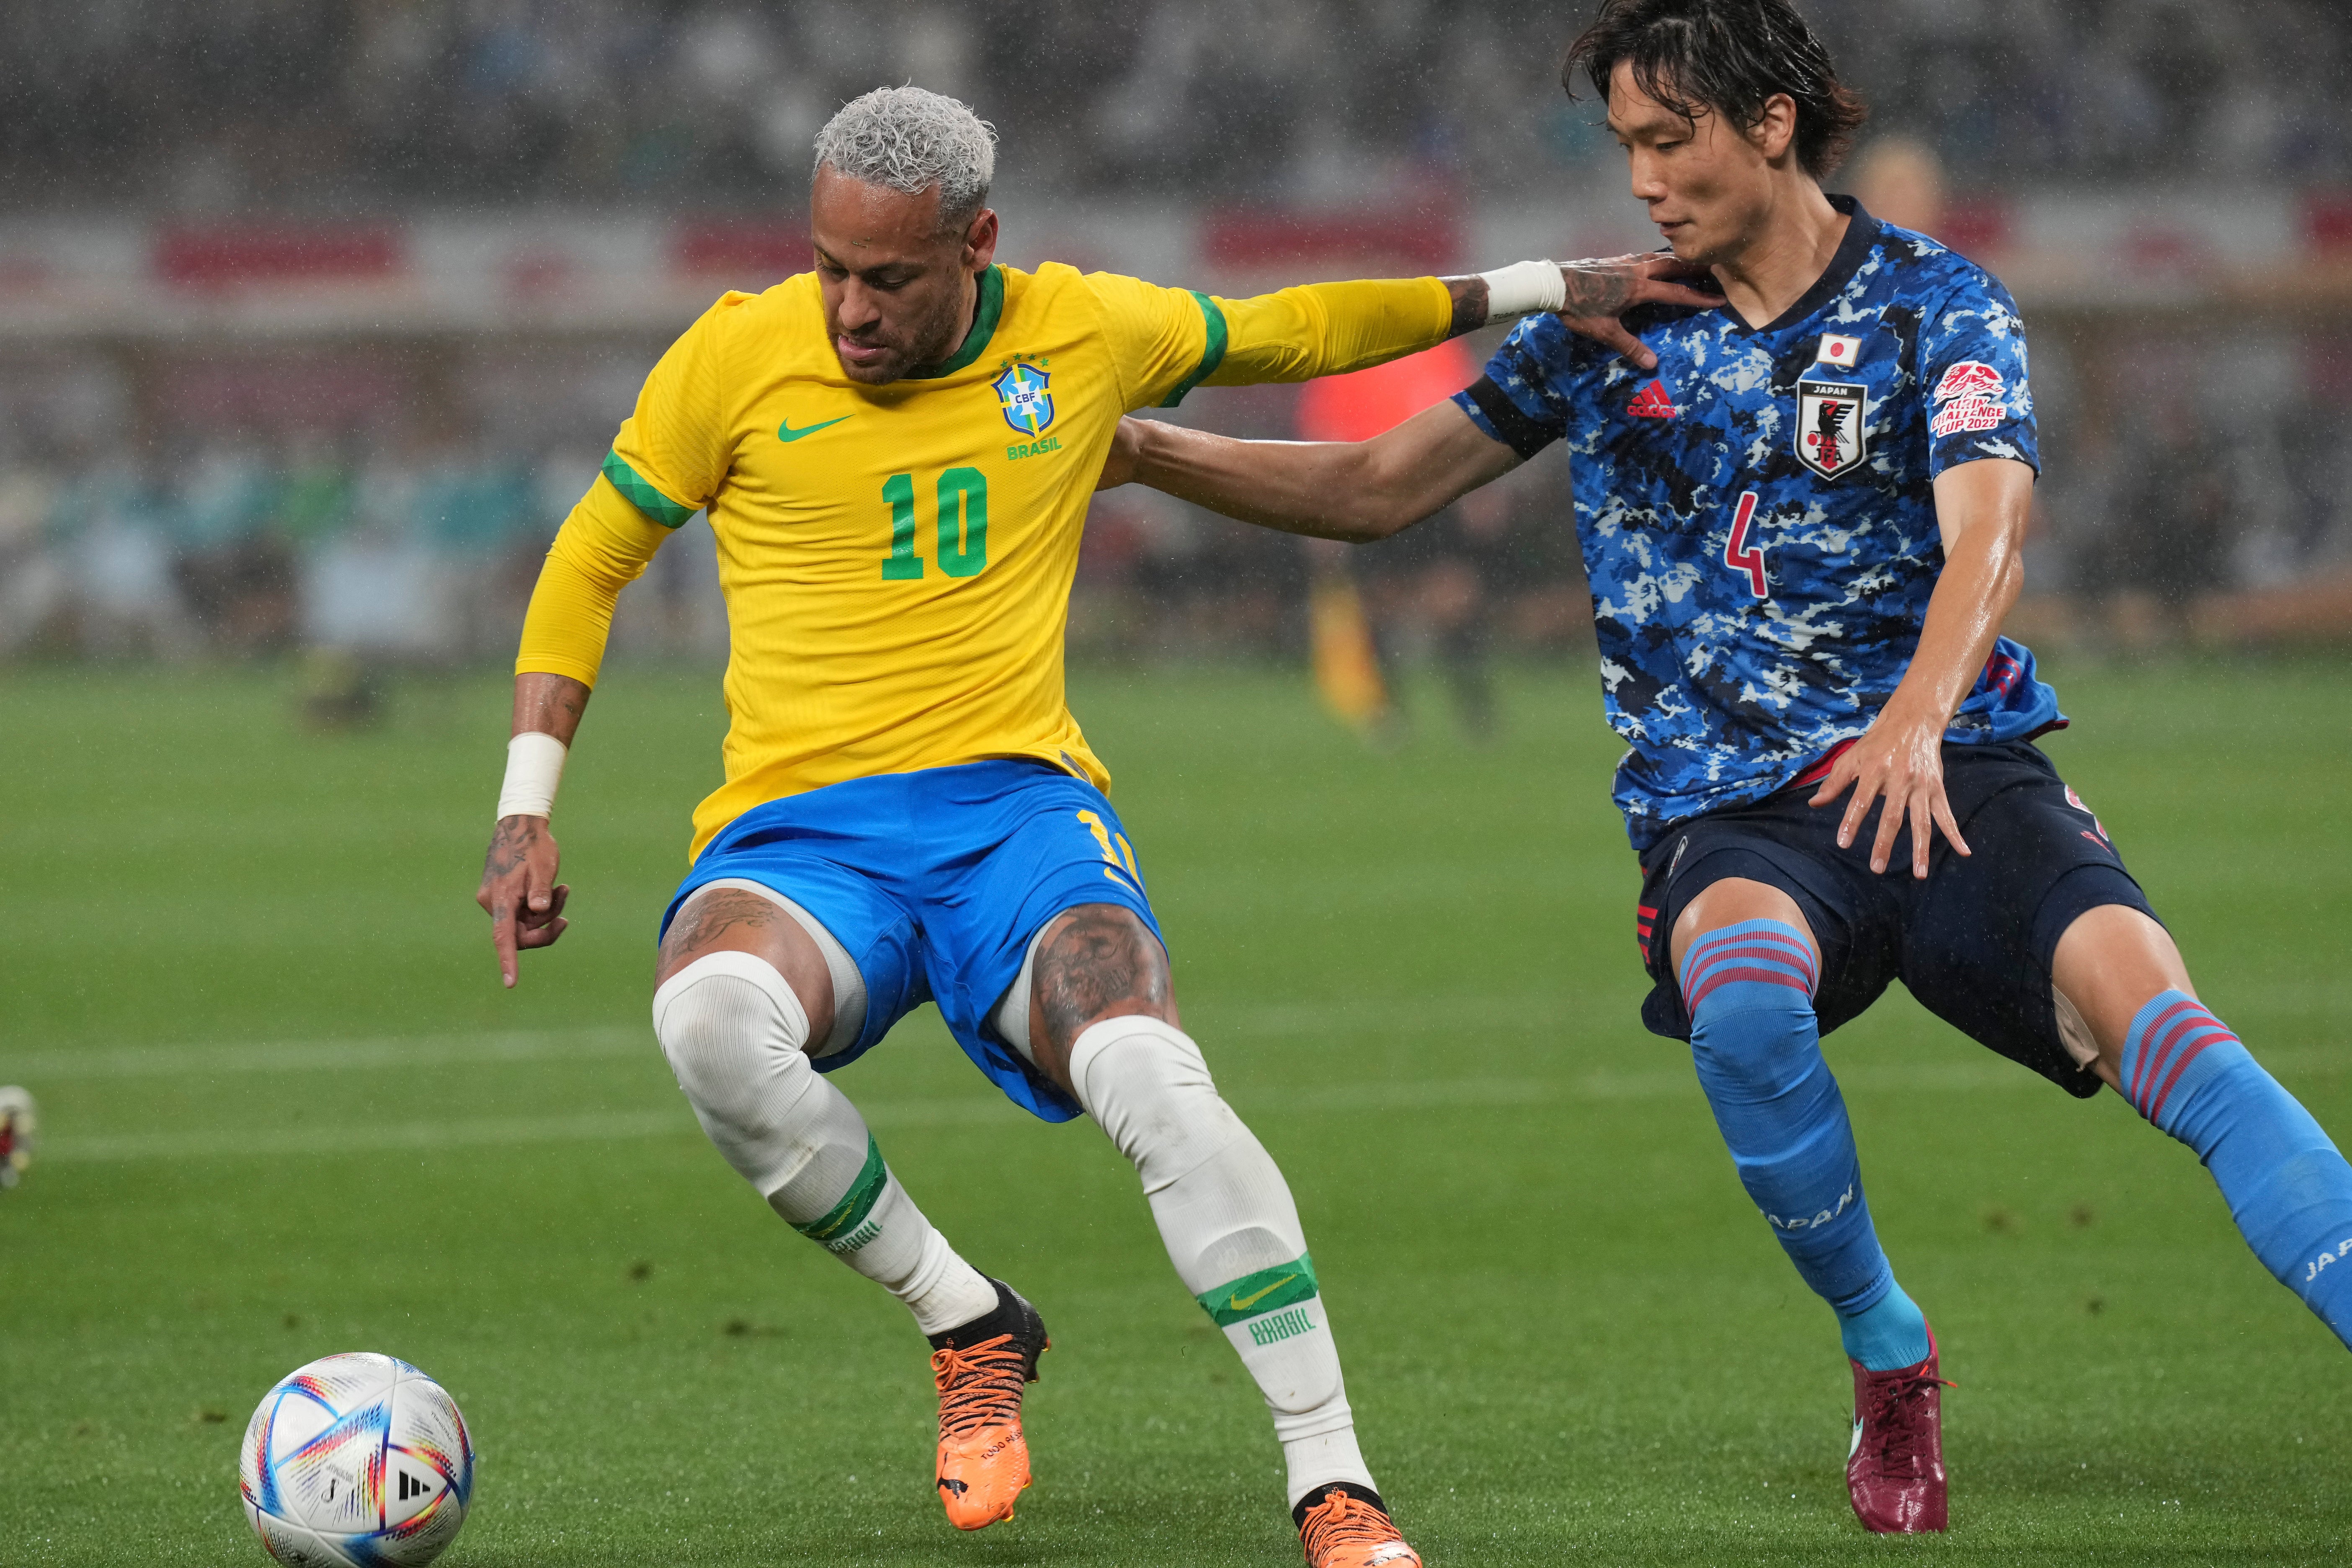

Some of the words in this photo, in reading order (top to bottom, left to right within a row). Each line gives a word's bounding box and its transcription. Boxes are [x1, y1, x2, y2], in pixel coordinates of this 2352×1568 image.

[1015, 392, 1035, 404] CBF
[1813, 386, 1848, 395] JAPAN
[1627, 402, 1676, 418] adidas
[1946, 399, 1987, 410] KIRIN
[1932, 407, 2004, 429] CHALLENGE
[1939, 420, 1964, 435] CUP
[1967, 418, 1996, 428] 2022
[1007, 436, 1062, 460] BRASIL
[1814, 448, 1844, 462] JFA
[882, 467, 988, 580] 10
[1724, 490, 1769, 599] 4
[1760, 1182, 1853, 1230] APAN
[1248, 1308, 1316, 1346] BRASIL
[980, 1442, 1006, 1460] TUDO
